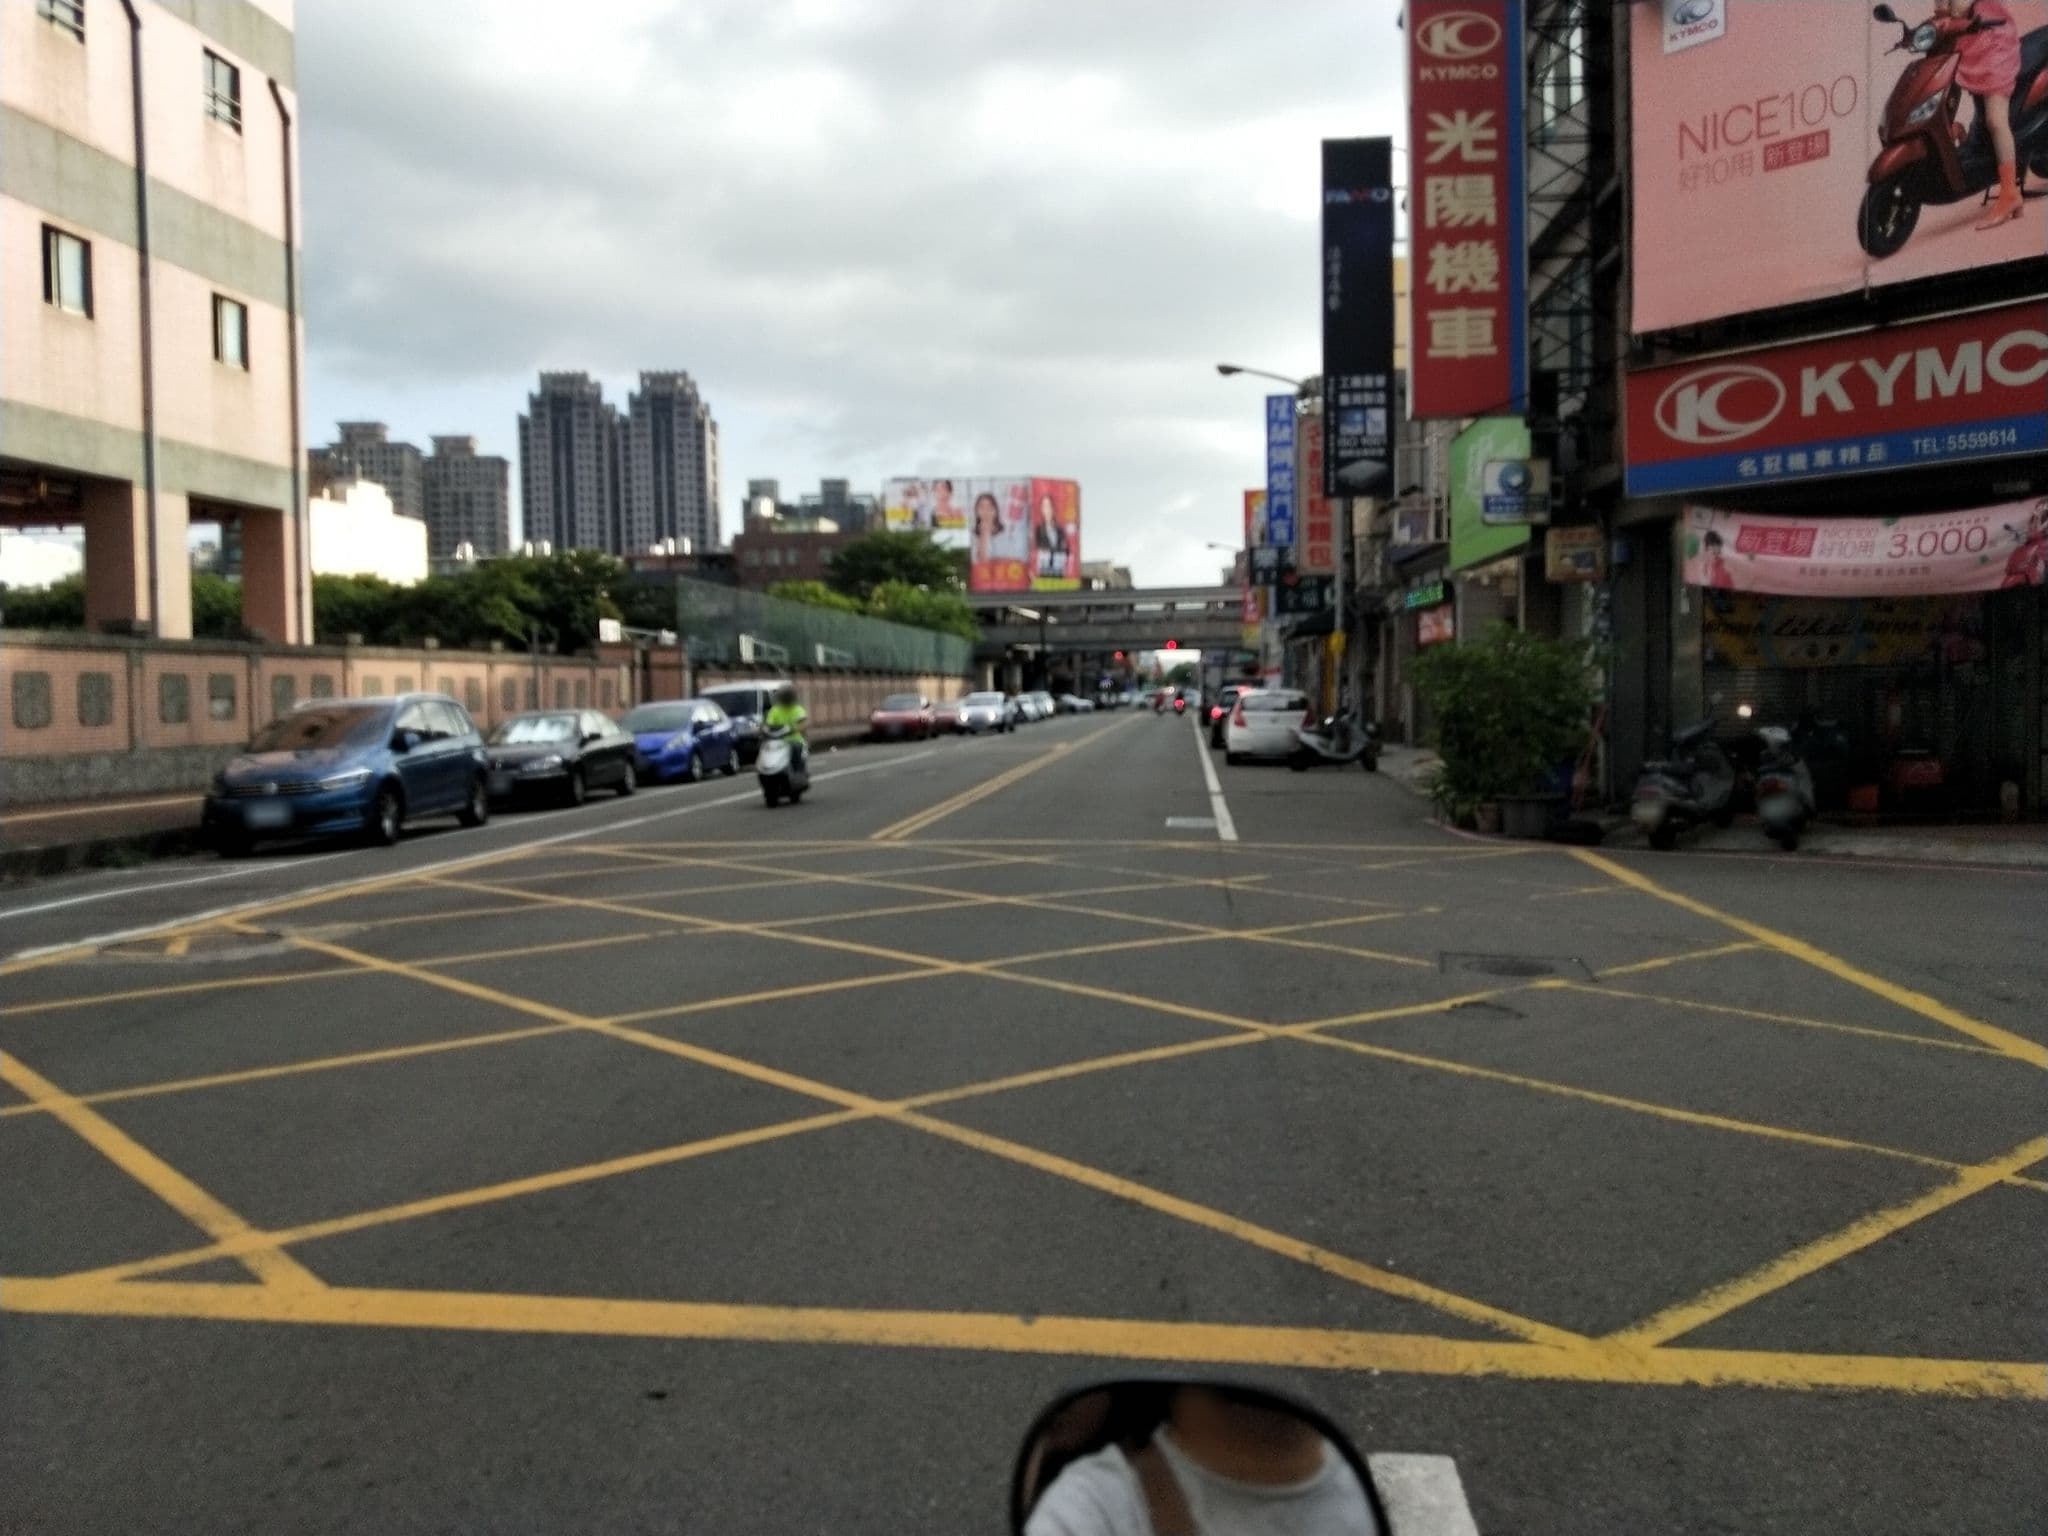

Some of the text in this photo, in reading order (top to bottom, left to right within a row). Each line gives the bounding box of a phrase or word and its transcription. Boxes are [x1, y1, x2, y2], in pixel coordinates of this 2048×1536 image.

[1669, 18, 1719, 42] KYMCO
[1420, 64, 1498, 81] KYMCO
[1678, 75, 1857, 161] NICE100
[1425, 110, 1499, 359] 光陽機車
